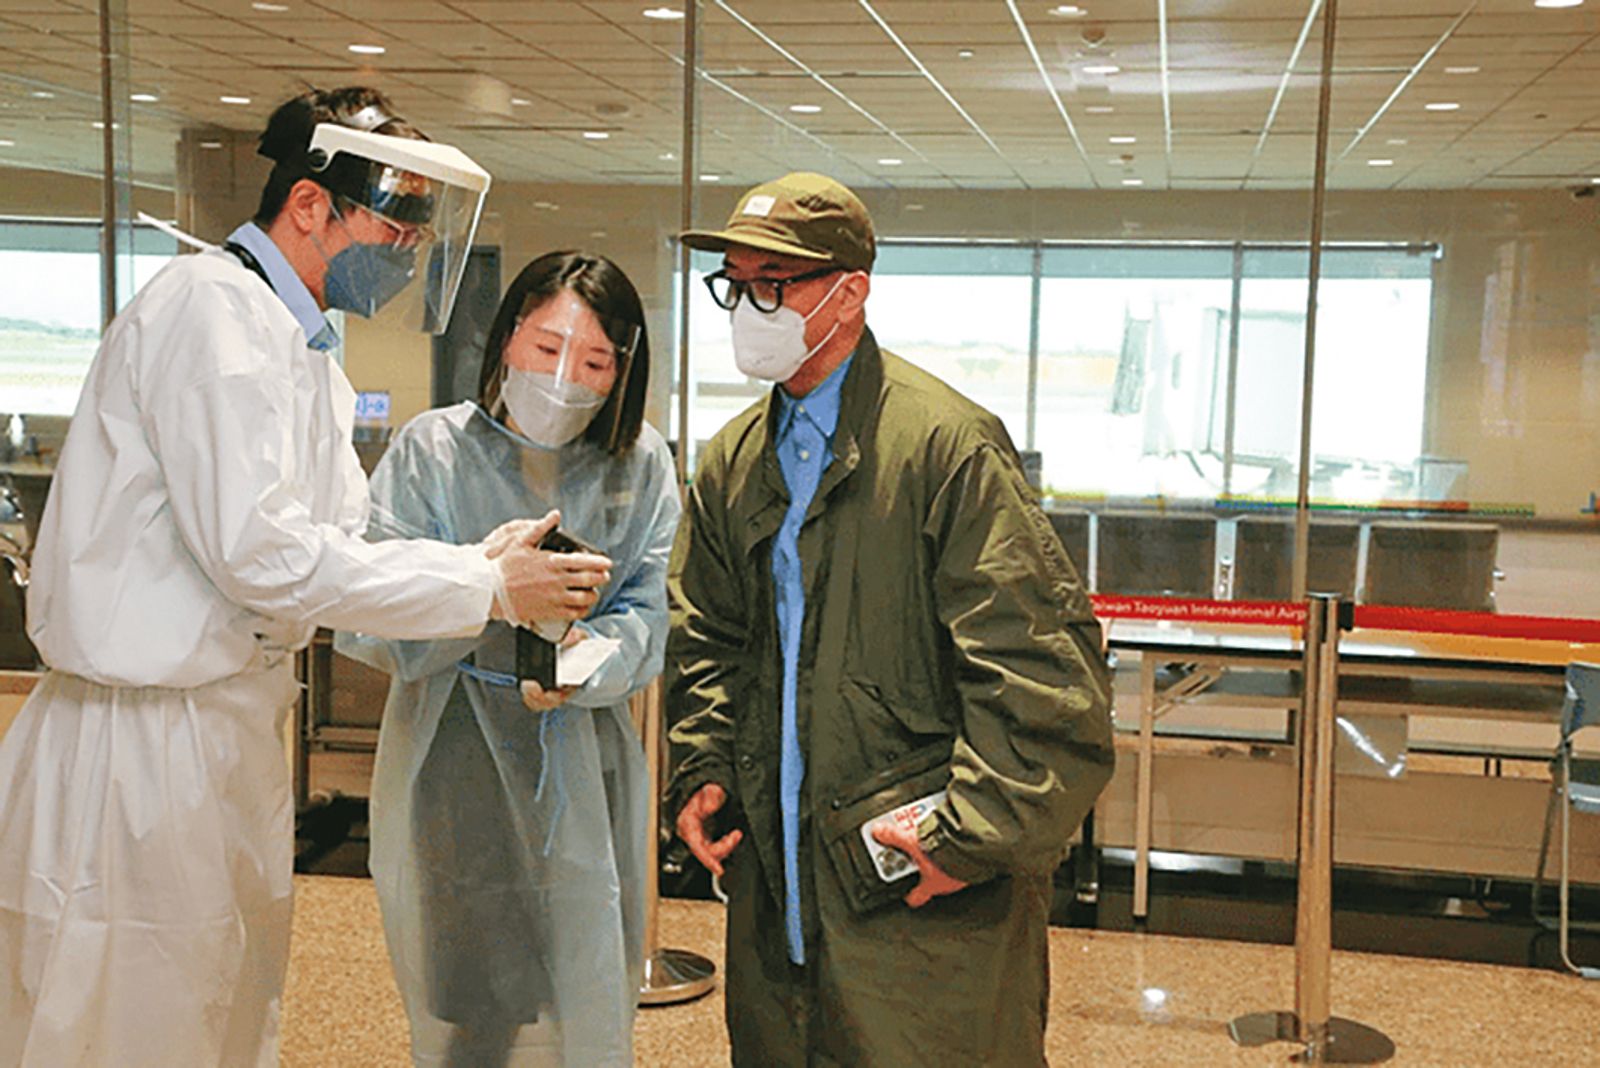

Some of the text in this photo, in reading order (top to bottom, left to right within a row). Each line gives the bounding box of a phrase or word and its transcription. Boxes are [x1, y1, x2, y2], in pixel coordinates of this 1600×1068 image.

[1091, 598, 1131, 613] aiwan
[1133, 600, 1188, 616] Taoyuan
[1190, 603, 1275, 618] International
